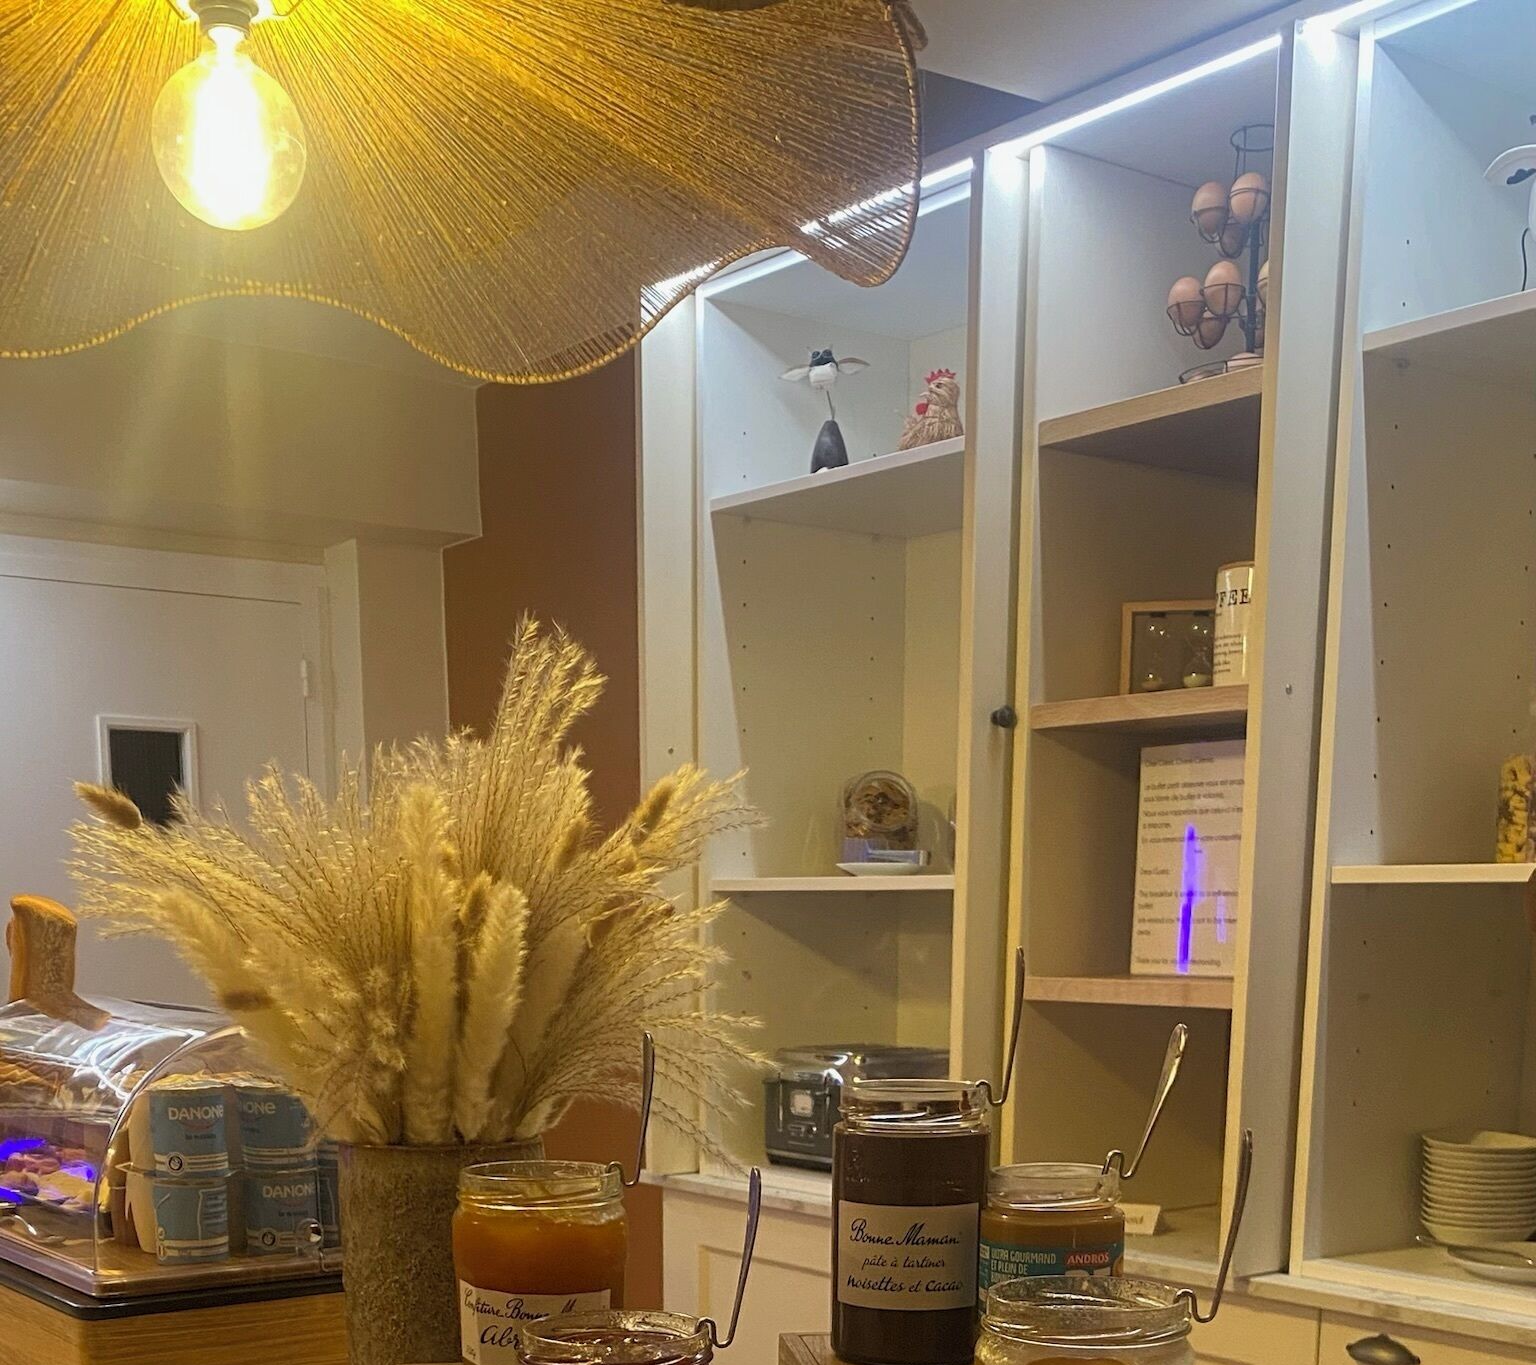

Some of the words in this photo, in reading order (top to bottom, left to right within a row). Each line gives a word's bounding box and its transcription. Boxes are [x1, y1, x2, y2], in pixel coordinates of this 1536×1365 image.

[1216, 588, 1251, 608] FEE
[850, 1218, 894, 1245] Bonne
[896, 1222, 960, 1246] Maman
[861, 1255, 887, 1271] pâte
[890, 1256, 897, 1268] à
[902, 1256, 945, 1268] tartiner
[1010, 1250, 1057, 1265] GOURMAND
[1066, 1252, 1109, 1265] ANDROS
[999, 1261, 1017, 1275] PLEIN
[1018, 1264, 1028, 1275] DE
[908, 1279, 921, 1293] et
[480, 1325, 521, 1351] Abr
